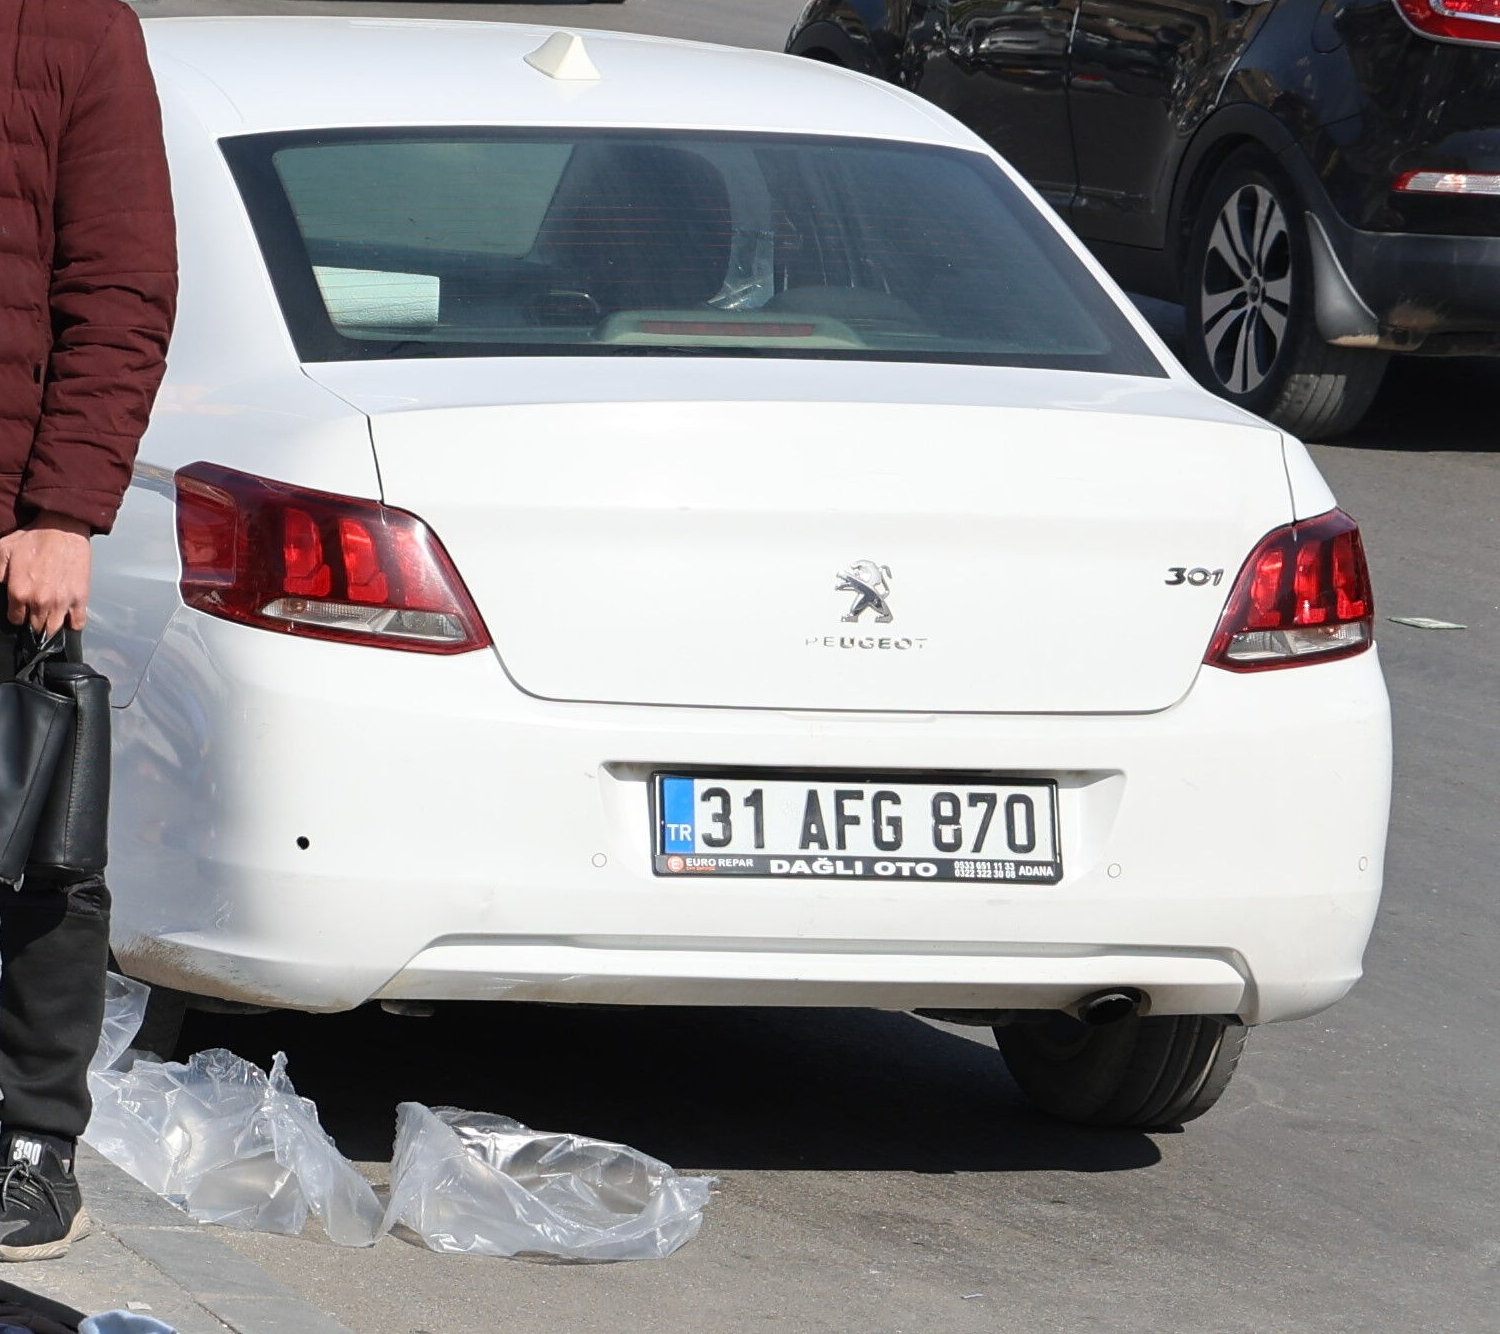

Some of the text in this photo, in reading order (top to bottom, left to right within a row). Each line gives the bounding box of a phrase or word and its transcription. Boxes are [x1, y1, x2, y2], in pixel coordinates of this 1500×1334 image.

[1164, 567, 1225, 586] 301
[805, 636, 928, 650] PEUGEOT
[700, 786, 1036, 853] 31 AFG 870
[666, 823, 693, 841] TR
[685, 858, 754, 868] EURO REPAR
[769, 857, 939, 877] DAĞLI OTO
[953, 860, 975, 870] 0533
[953, 868, 975, 878] 0322
[1018, 865, 1054, 877] ADANA
